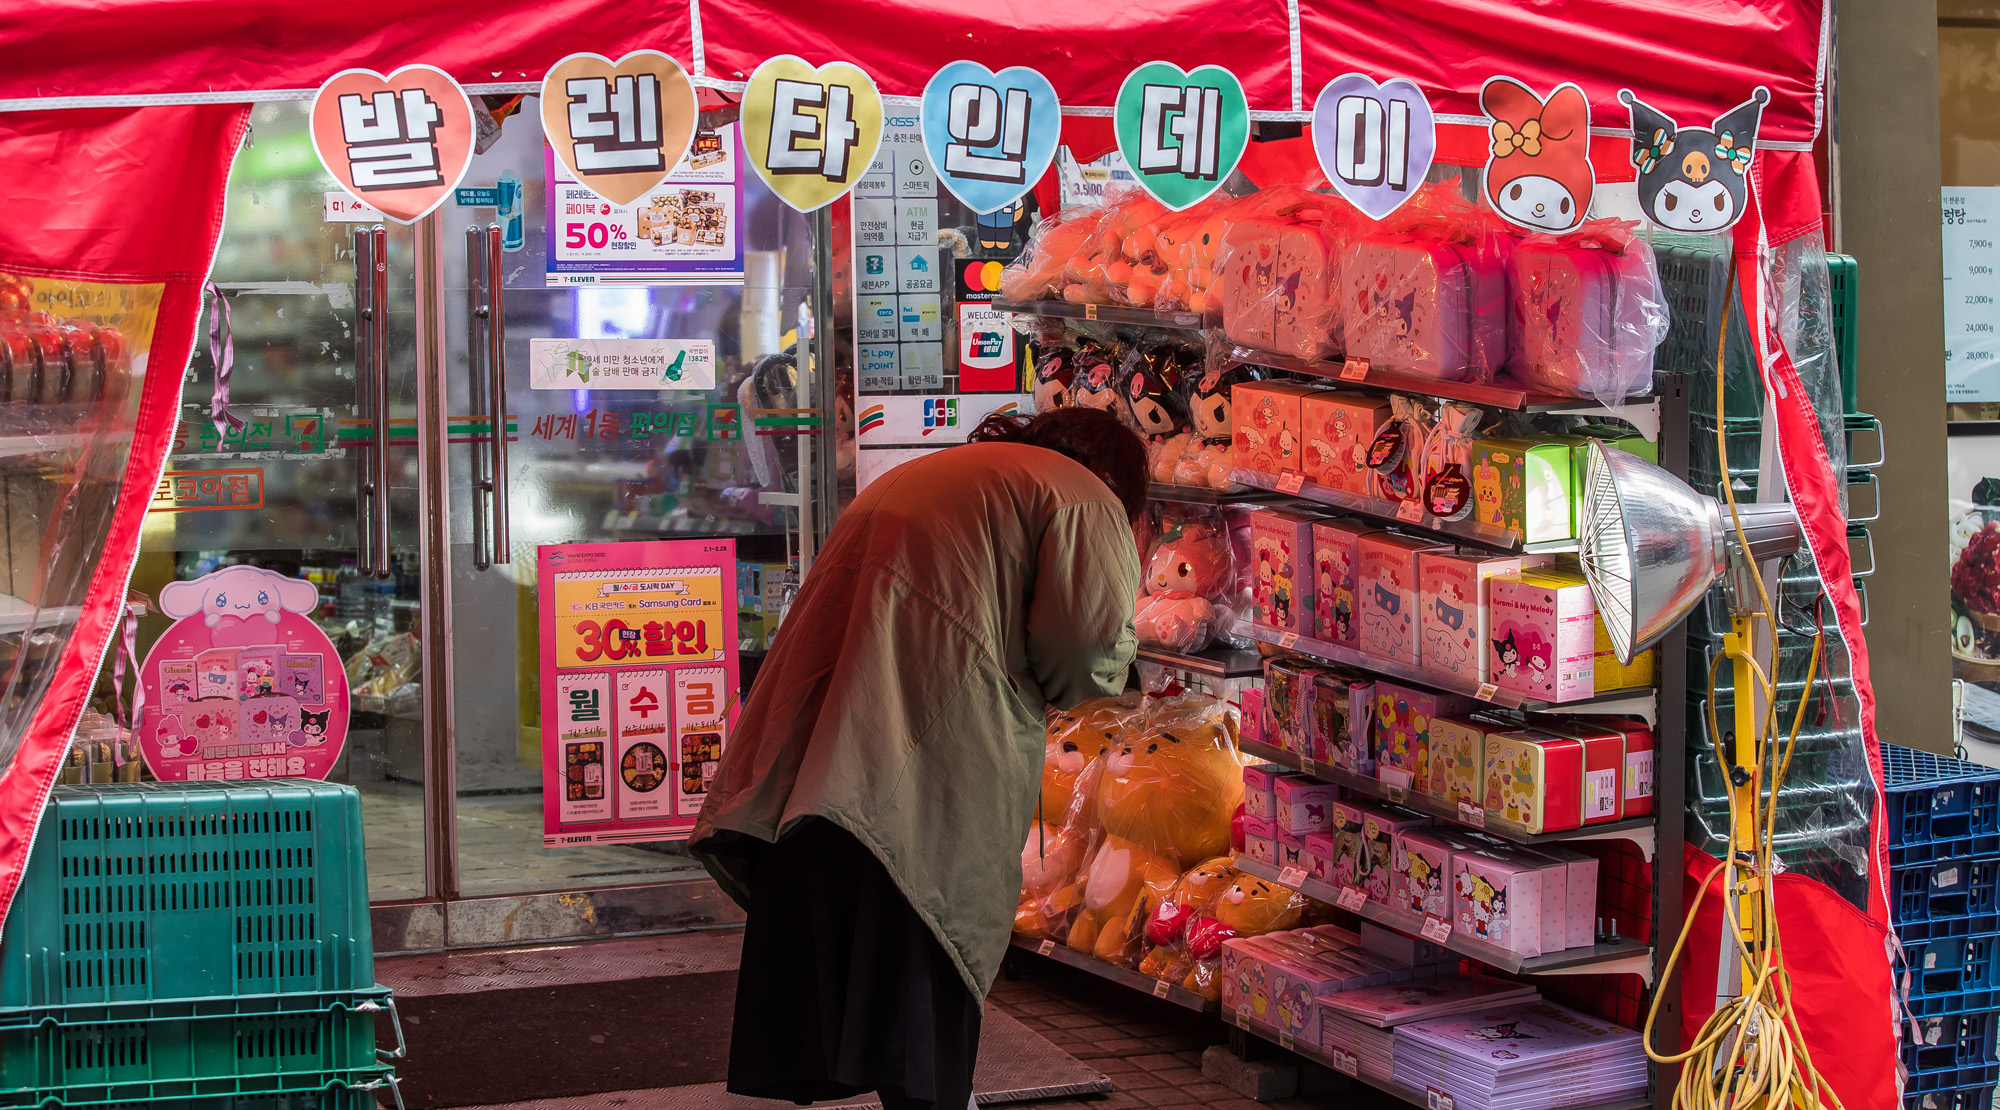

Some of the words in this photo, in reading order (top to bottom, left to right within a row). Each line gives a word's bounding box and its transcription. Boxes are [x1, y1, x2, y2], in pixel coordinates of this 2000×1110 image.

[338, 88, 444, 192] 발
[564, 73, 667, 176] 렌
[765, 78, 860, 183] 타
[944, 83, 1032, 185] 인
[1138, 84, 1223, 181] 데
[1336, 95, 1411, 192] 이
[902, 181, 930, 190] 스마트픽
[565, 203, 596, 215] 페이북
[906, 207, 928, 216] ATM
[1941, 207, 1967, 225] 렁탕
[860, 221, 887, 230] 안전상비
[910, 221, 924, 229] 현금
[565, 222, 628, 249] 50%
[863, 232, 885, 241] 의약품
[907, 232, 928, 240] 지급기
[861, 281, 890, 289] 세븐APP
[906, 280, 933, 289] 공공요금
[967, 311, 1005, 319] WELCOME
[859, 329, 880, 339] 모바일
[882, 328, 896, 338] 결제
[972, 338, 1002, 347] UnionPay
[603, 355, 620, 365] 미만
[622, 355, 665, 365] 청소년에게
[591, 367, 600, 376] 술
[603, 367, 620, 376] 담배
[622, 366, 639, 376] 판매
[641, 366, 659, 376] 금지
[531, 413, 577, 440] 세계
[585, 409, 621, 440] 1등
[629, 411, 696, 438] 편의점
[1267, 525, 1291, 538] characters
[639, 598, 679, 609] Samsung
[681, 598, 702, 607] Card
[1519, 602, 1529, 612] My
[1530, 604, 1554, 616] Melody
[622, 630, 637, 640] 현장
[643, 619, 708, 657] 할인
[285, 660, 316, 668] Ghana
[163, 666, 192, 674] Ghana
[629, 686, 659, 719] 수
[685, 682, 715, 715] 금
[569, 688, 600, 722] 월
[202, 742, 287, 760] 세븐일레븐에서
[186, 760, 244, 781] 마음을
[248, 757, 307, 778] 전해요
